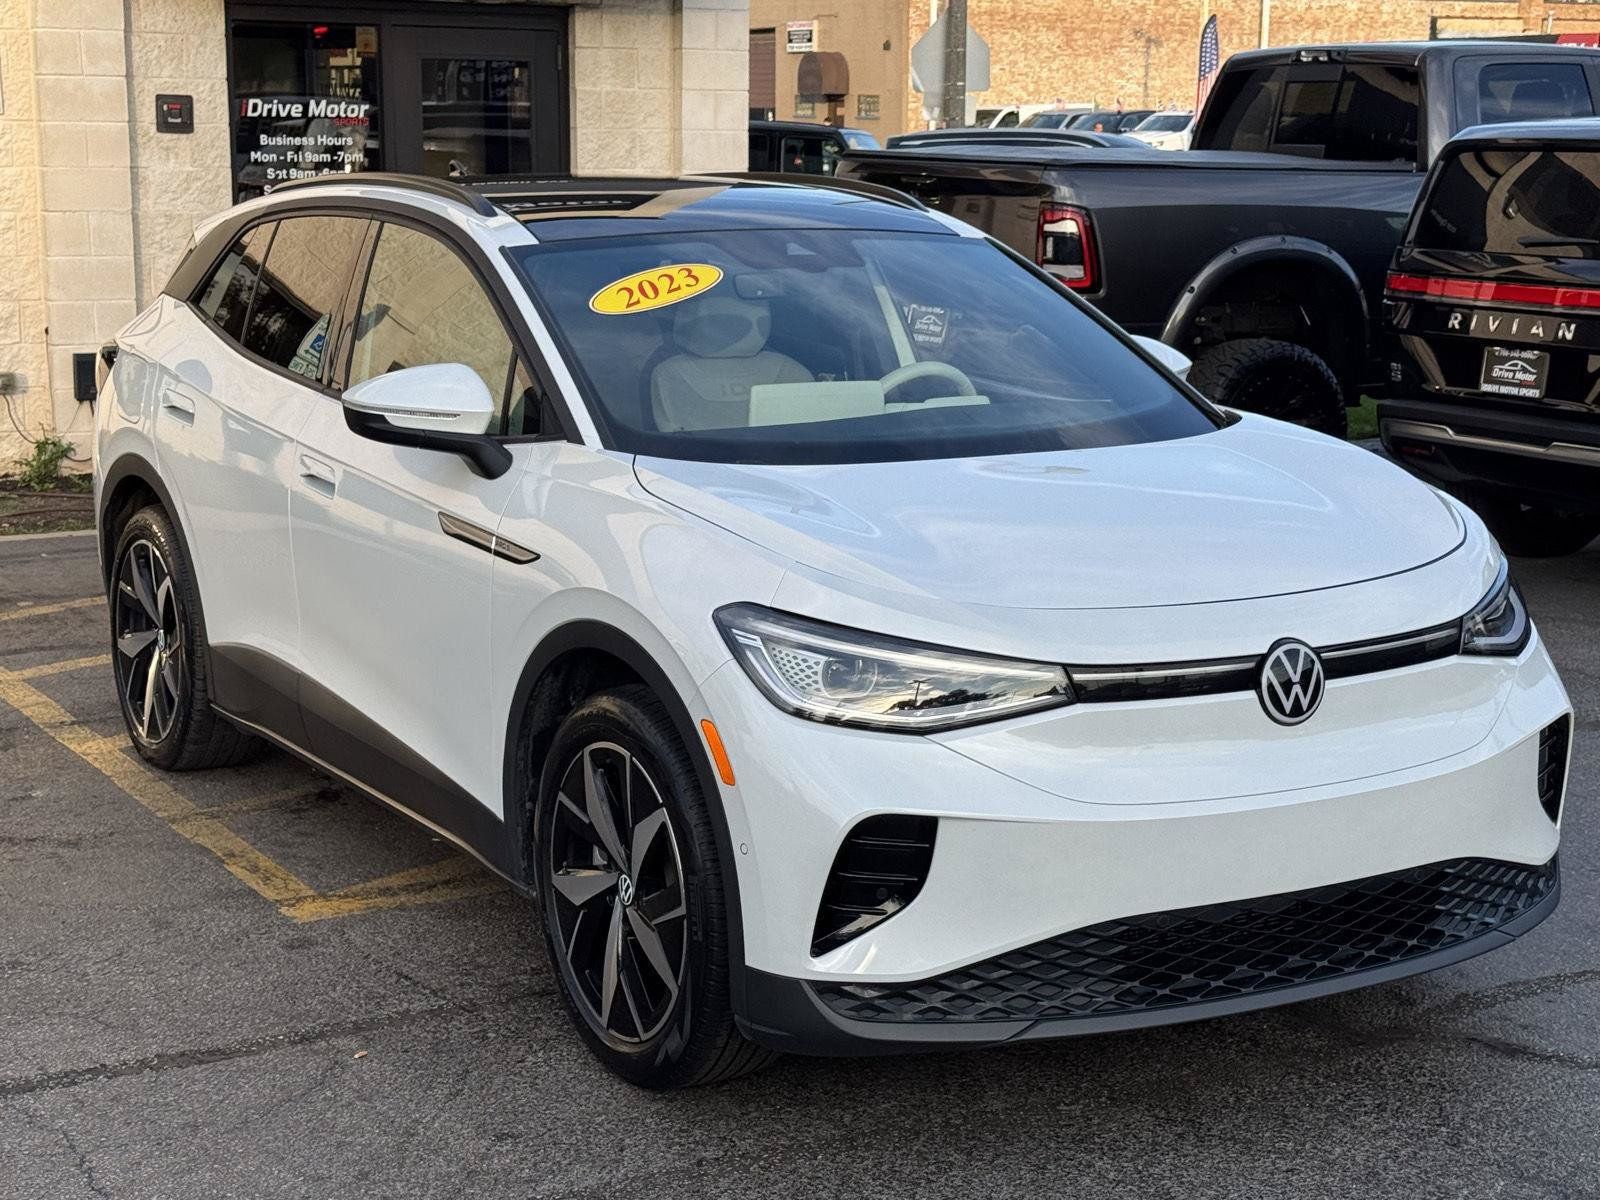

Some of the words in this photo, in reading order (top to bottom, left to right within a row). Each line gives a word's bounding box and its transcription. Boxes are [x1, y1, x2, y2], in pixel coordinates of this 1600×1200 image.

[240, 97, 303, 118] iDrive
[308, 99, 369, 118] Motor
[259, 134, 315, 146] Business
[317, 134, 354, 146] Hours
[250, 151, 277, 163] Mon
[286, 151, 303, 163] Fri
[304, 152, 331, 163] 9am
[266, 168, 288, 179] Sat
[289, 168, 316, 179] 9am
[616, 267, 699, 309] 2023
[1447, 312, 1576, 341] RIVIAN
[1514, 371, 1538, 382] Motor
